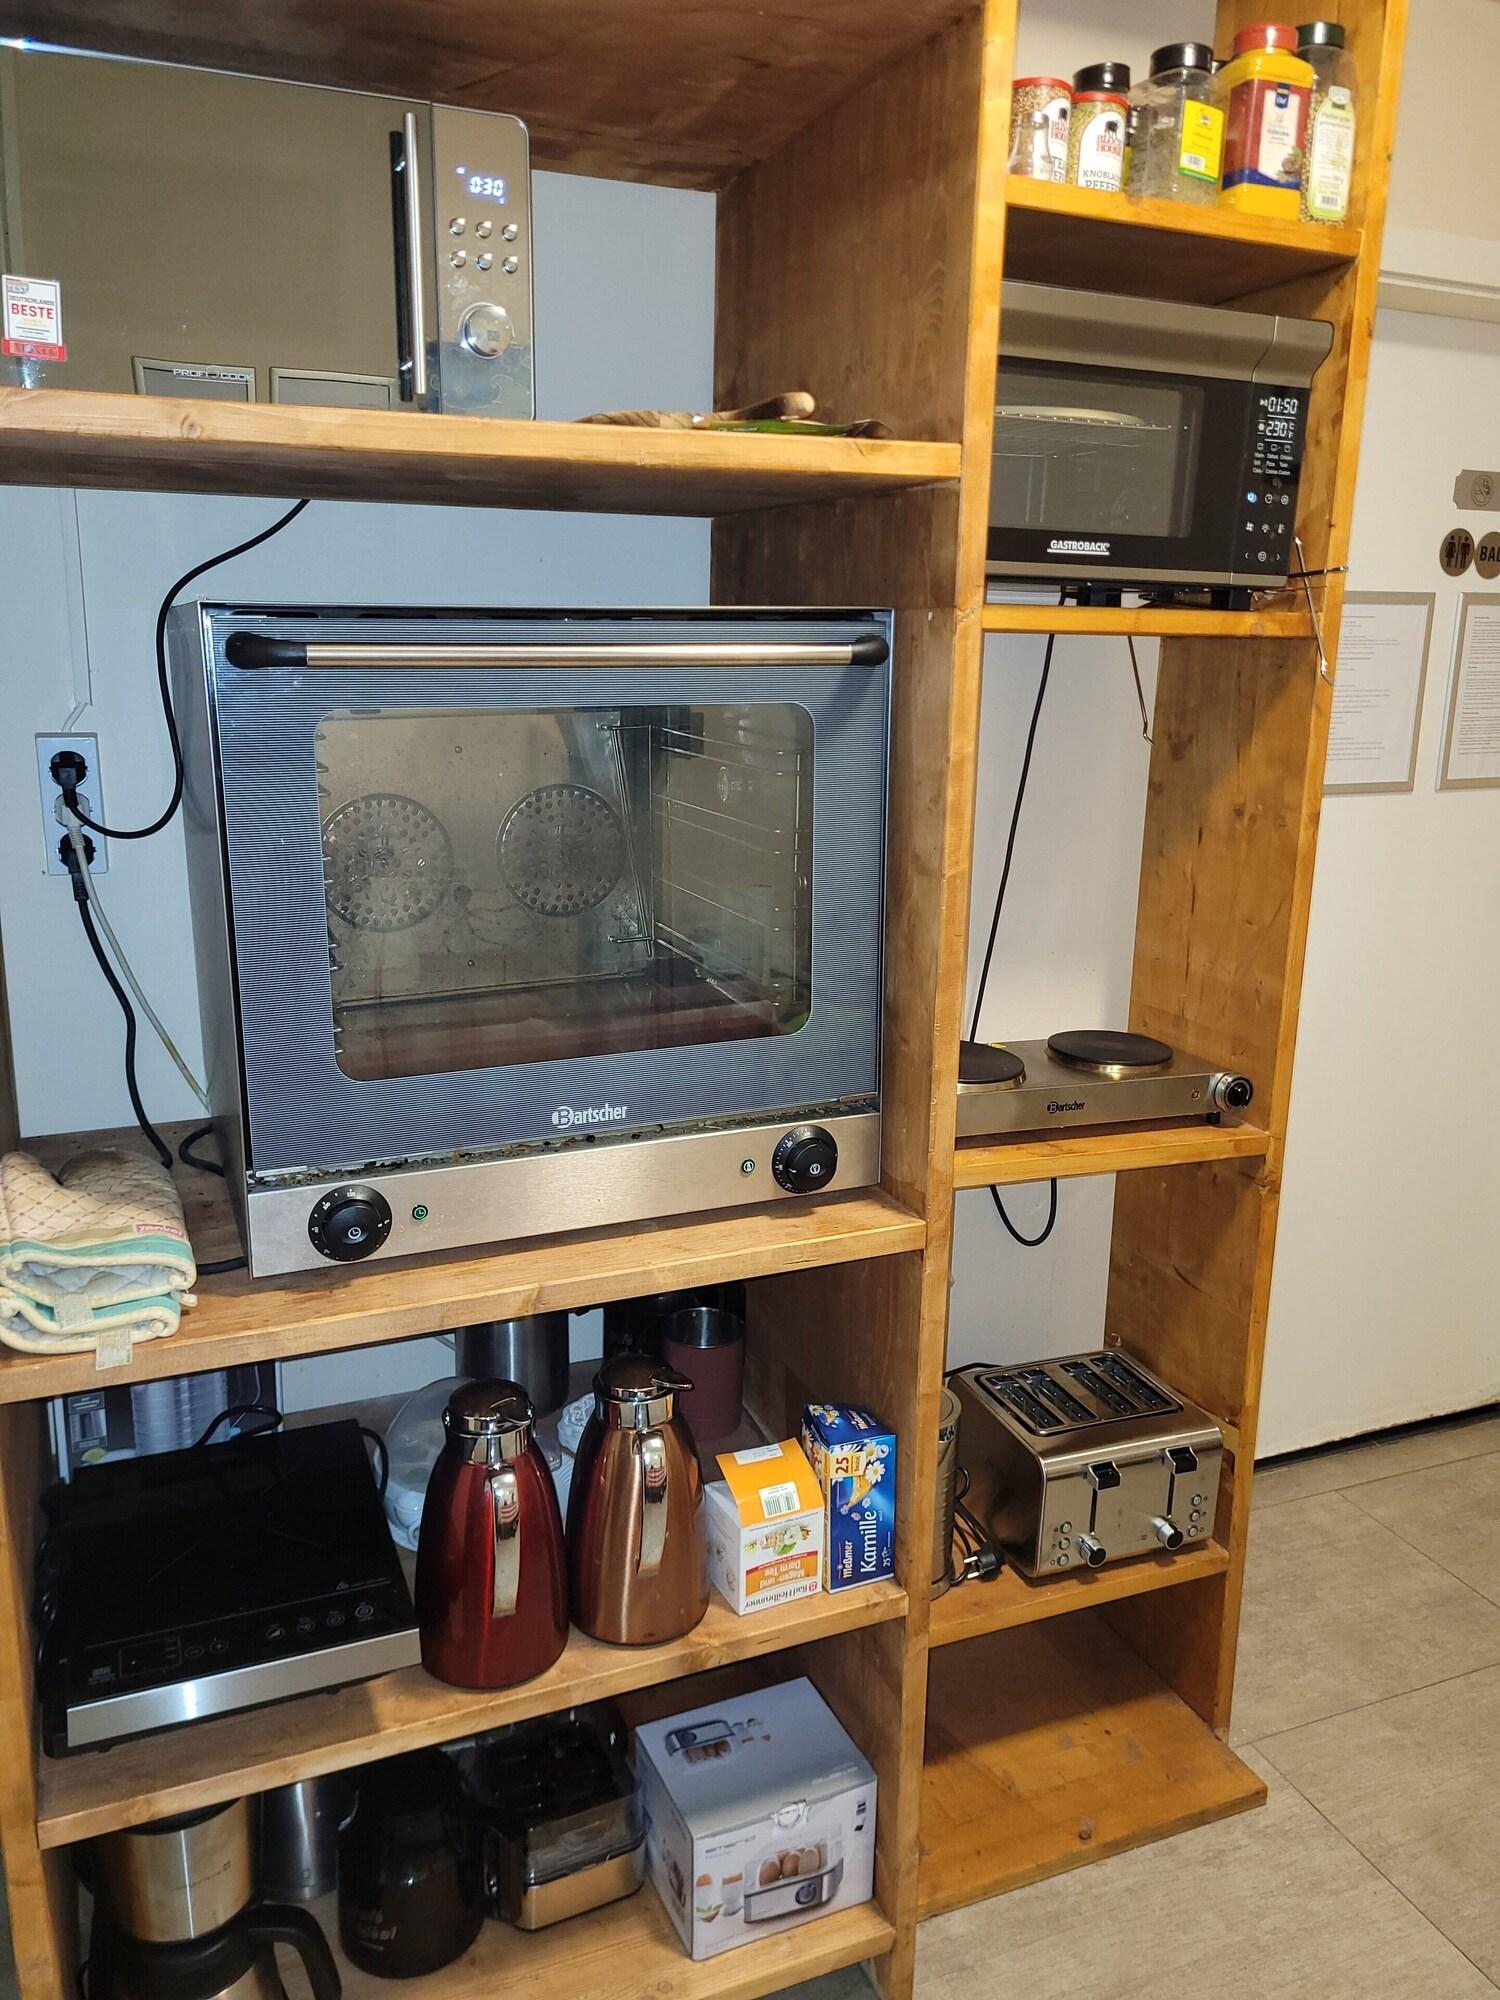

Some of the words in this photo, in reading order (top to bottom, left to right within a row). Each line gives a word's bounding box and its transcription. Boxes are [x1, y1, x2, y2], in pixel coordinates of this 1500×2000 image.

[11, 303, 55, 320] BESTE
[173, 369, 209, 378] PROFI
[1268, 396, 1298, 414] 01:50
[1265, 421, 1288, 437] 230
[1050, 539, 1106, 552] GASTROBACK
[1046, 1100, 1086, 1114] Bartscher
[551, 1103, 628, 1129] Bartscher
[836, 1456, 850, 1475] 25
[859, 1510, 877, 1573] Kamille
[843, 1540, 853, 1579] Meßmer
[883, 1556, 891, 1568] 25
